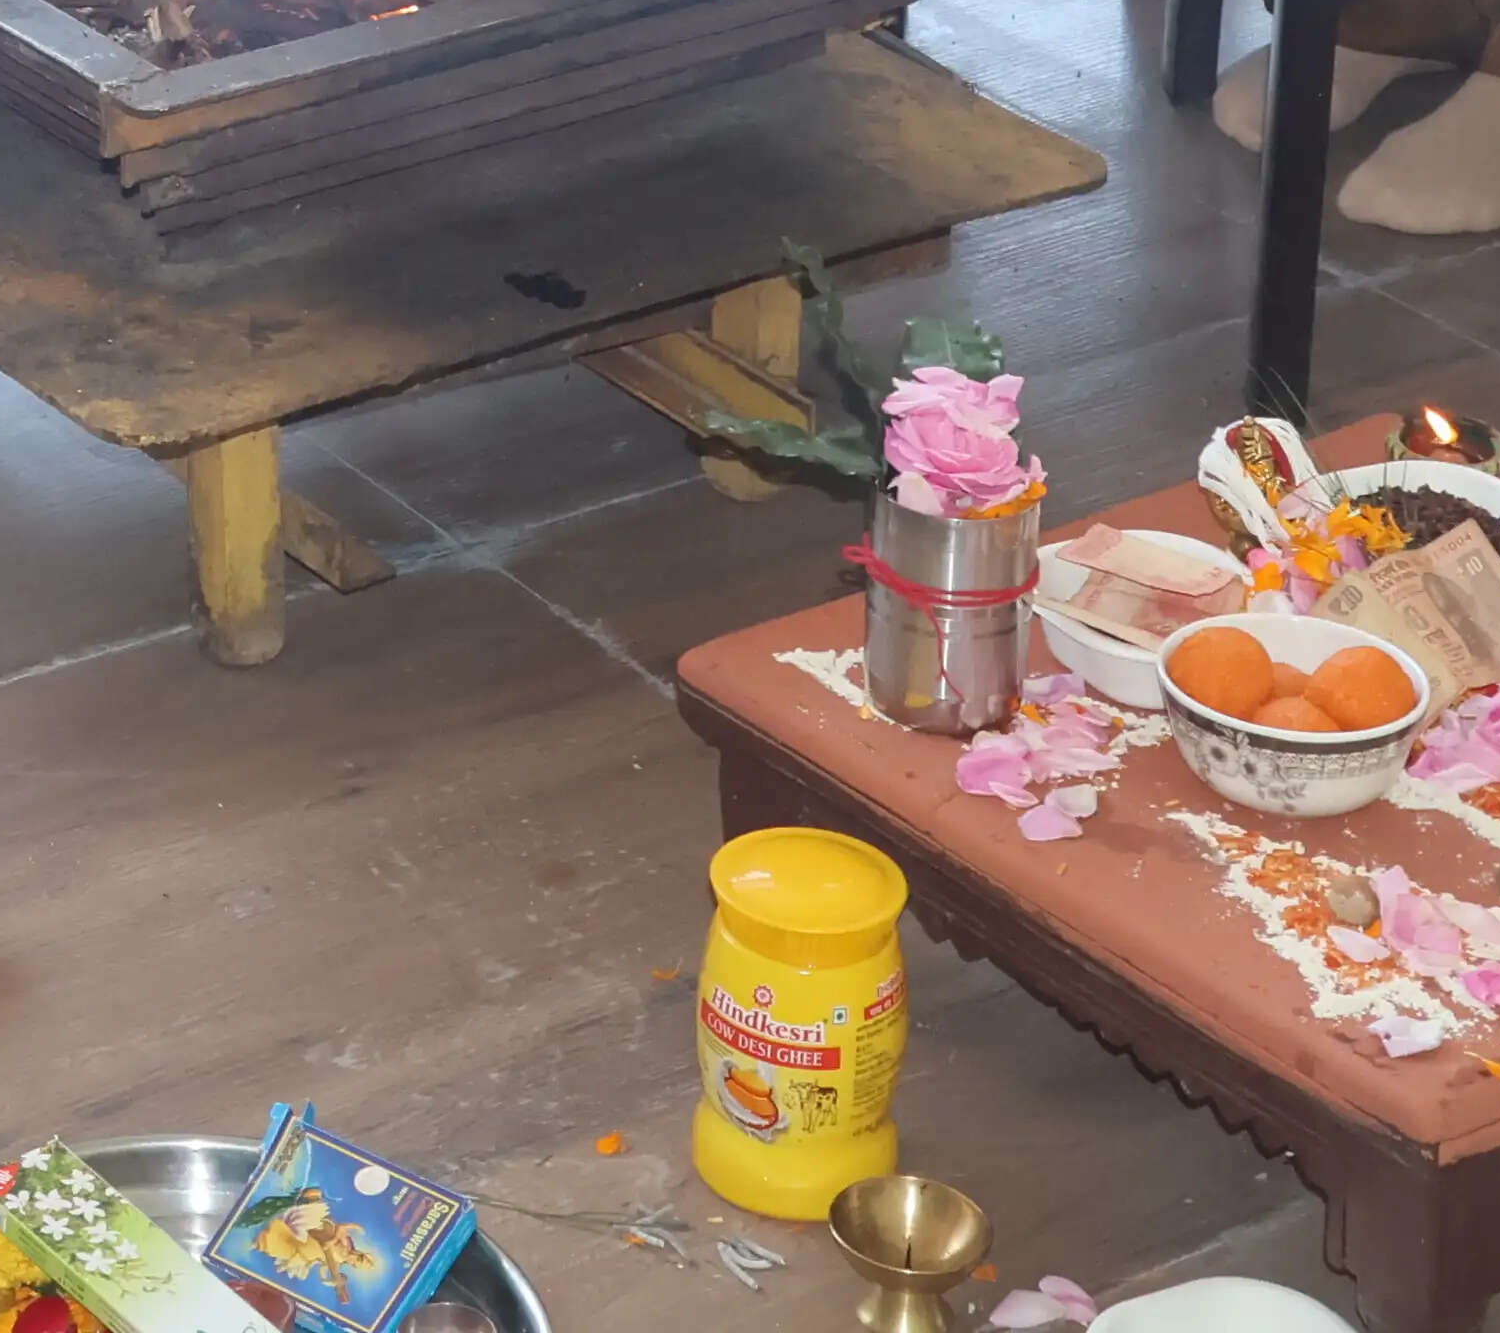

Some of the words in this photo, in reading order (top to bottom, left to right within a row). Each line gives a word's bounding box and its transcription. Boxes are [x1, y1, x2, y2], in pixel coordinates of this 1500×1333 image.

[707, 1013, 736, 1041] COW
[738, 1033, 772, 1059] DESI
[776, 1048, 823, 1067] GHEE
[711, 985, 825, 1044] Hindkesri
